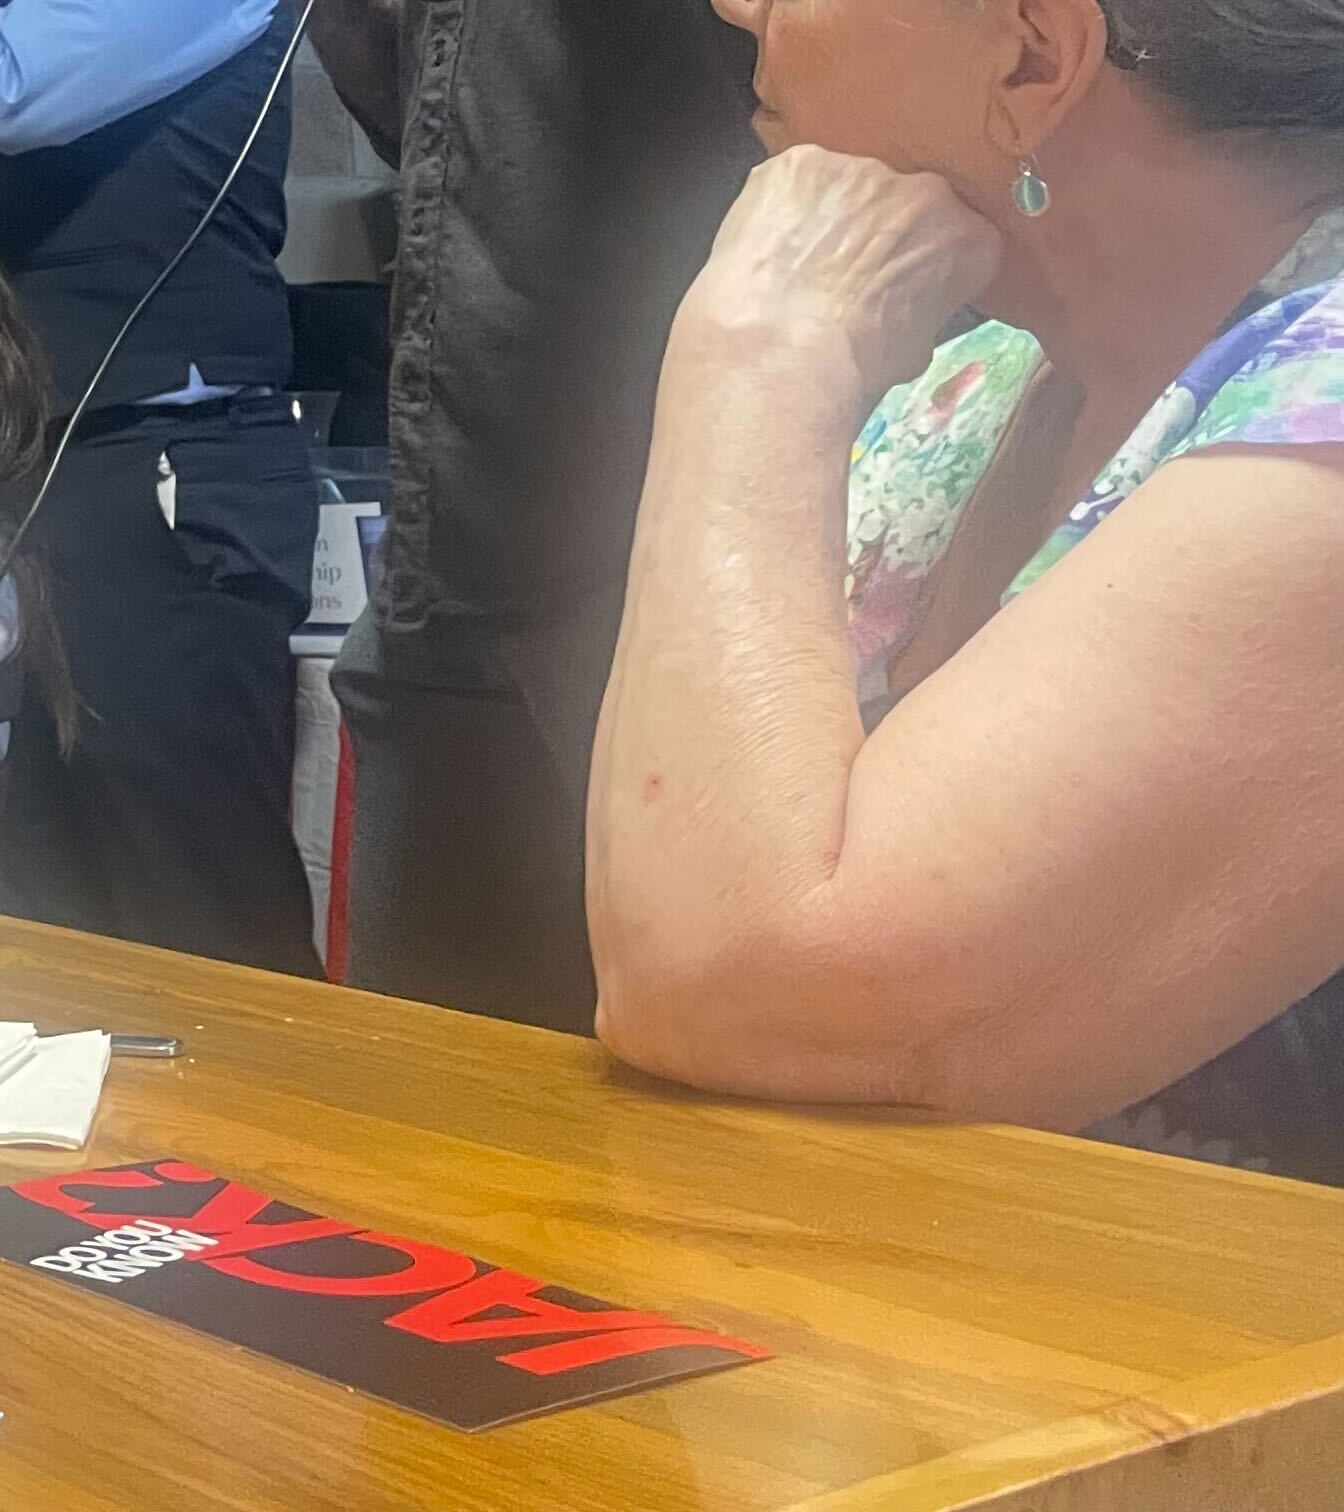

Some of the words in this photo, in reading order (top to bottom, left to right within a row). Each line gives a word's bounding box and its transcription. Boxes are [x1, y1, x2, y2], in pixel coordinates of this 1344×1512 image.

[29, 1245, 108, 1273] DO
[79, 1219, 173, 1251] YOU
[73, 1229, 220, 1284] KNOW
